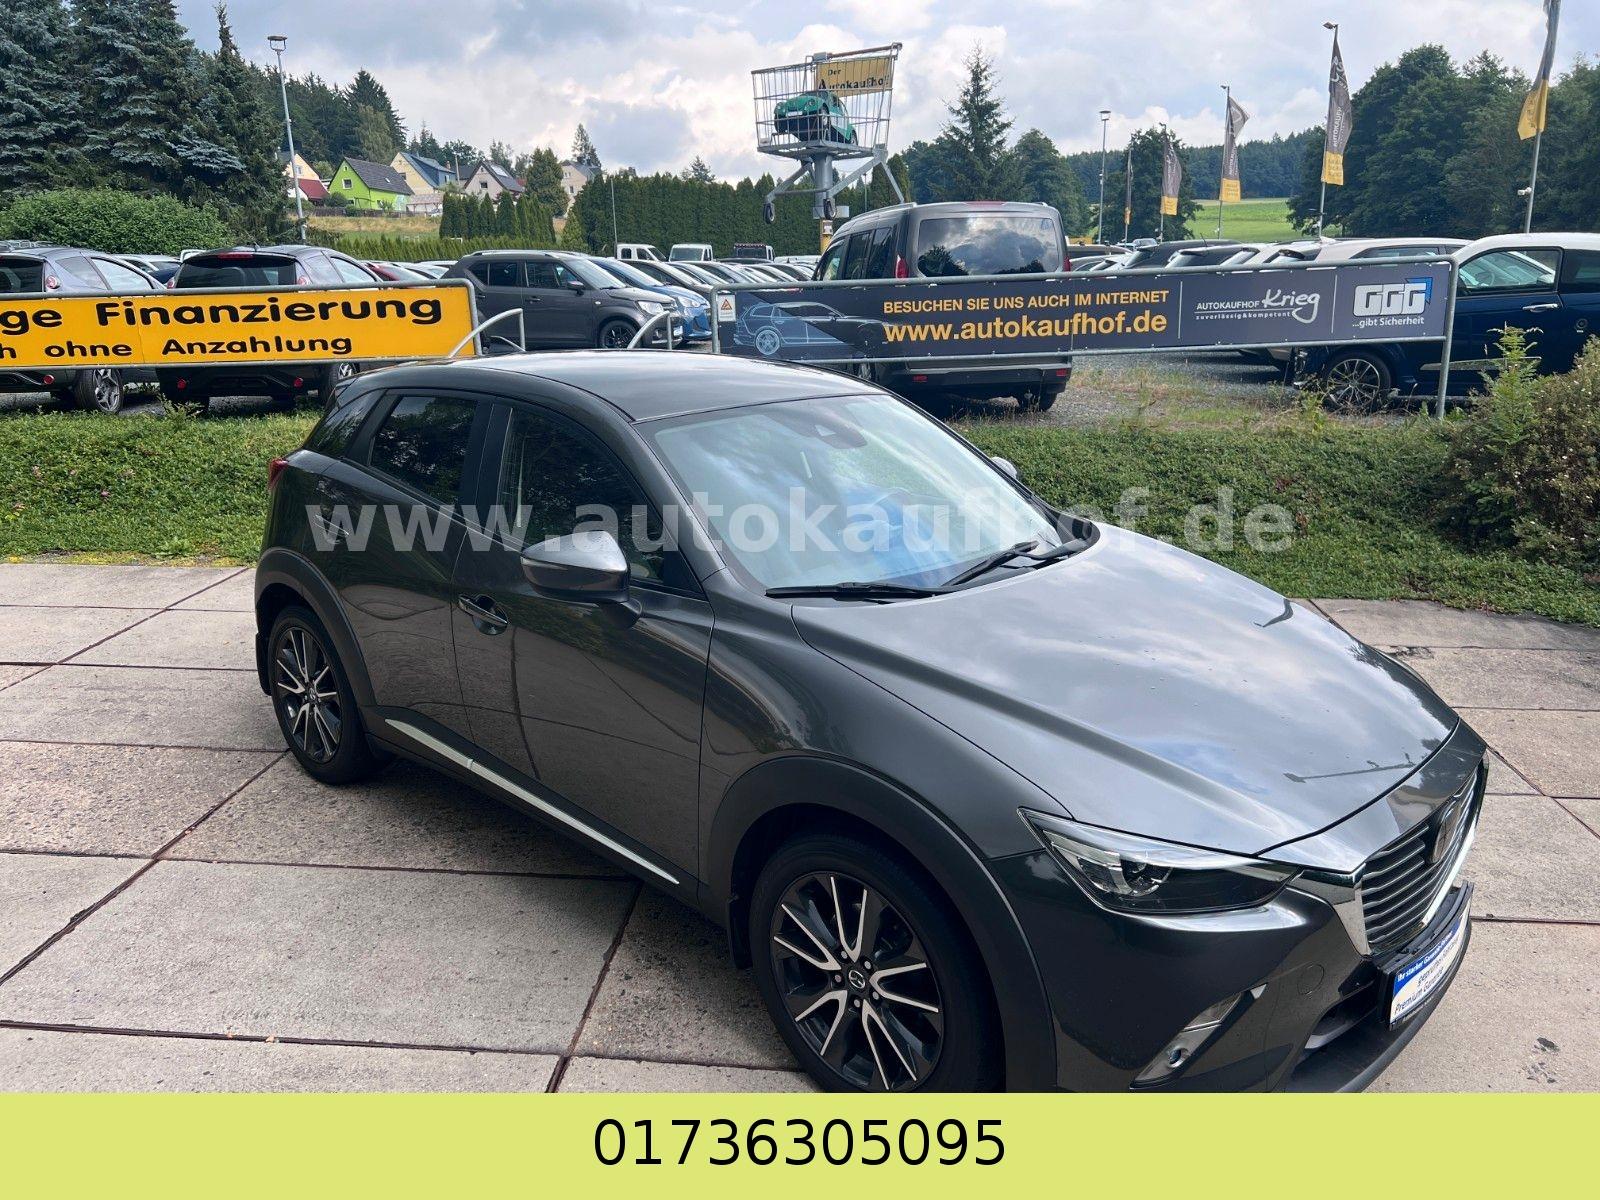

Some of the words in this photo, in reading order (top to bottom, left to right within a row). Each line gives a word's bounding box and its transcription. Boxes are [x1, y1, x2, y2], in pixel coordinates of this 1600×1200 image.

[0, 310, 63, 335] ge
[96, 297, 442, 327] Finanzierung
[883, 299, 963, 314] BESUCHEN
[967, 298, 989, 313] SIE
[994, 297, 1024, 311] UNS
[1028, 296, 1069, 310] AUCH
[1075, 294, 1092, 308] IM
[1096, 290, 1169, 307] INTERNET
[1196, 300, 1260, 310] AUTOKAUFHOF
[1262, 288, 1320, 323] Krieg
[884, 309, 1168, 343] www.autokaufhof.de
[1379, 316, 1425, 326] Sicherheit
[45, 340, 132, 358] ohne
[161, 336, 352, 356] Anzahlung
